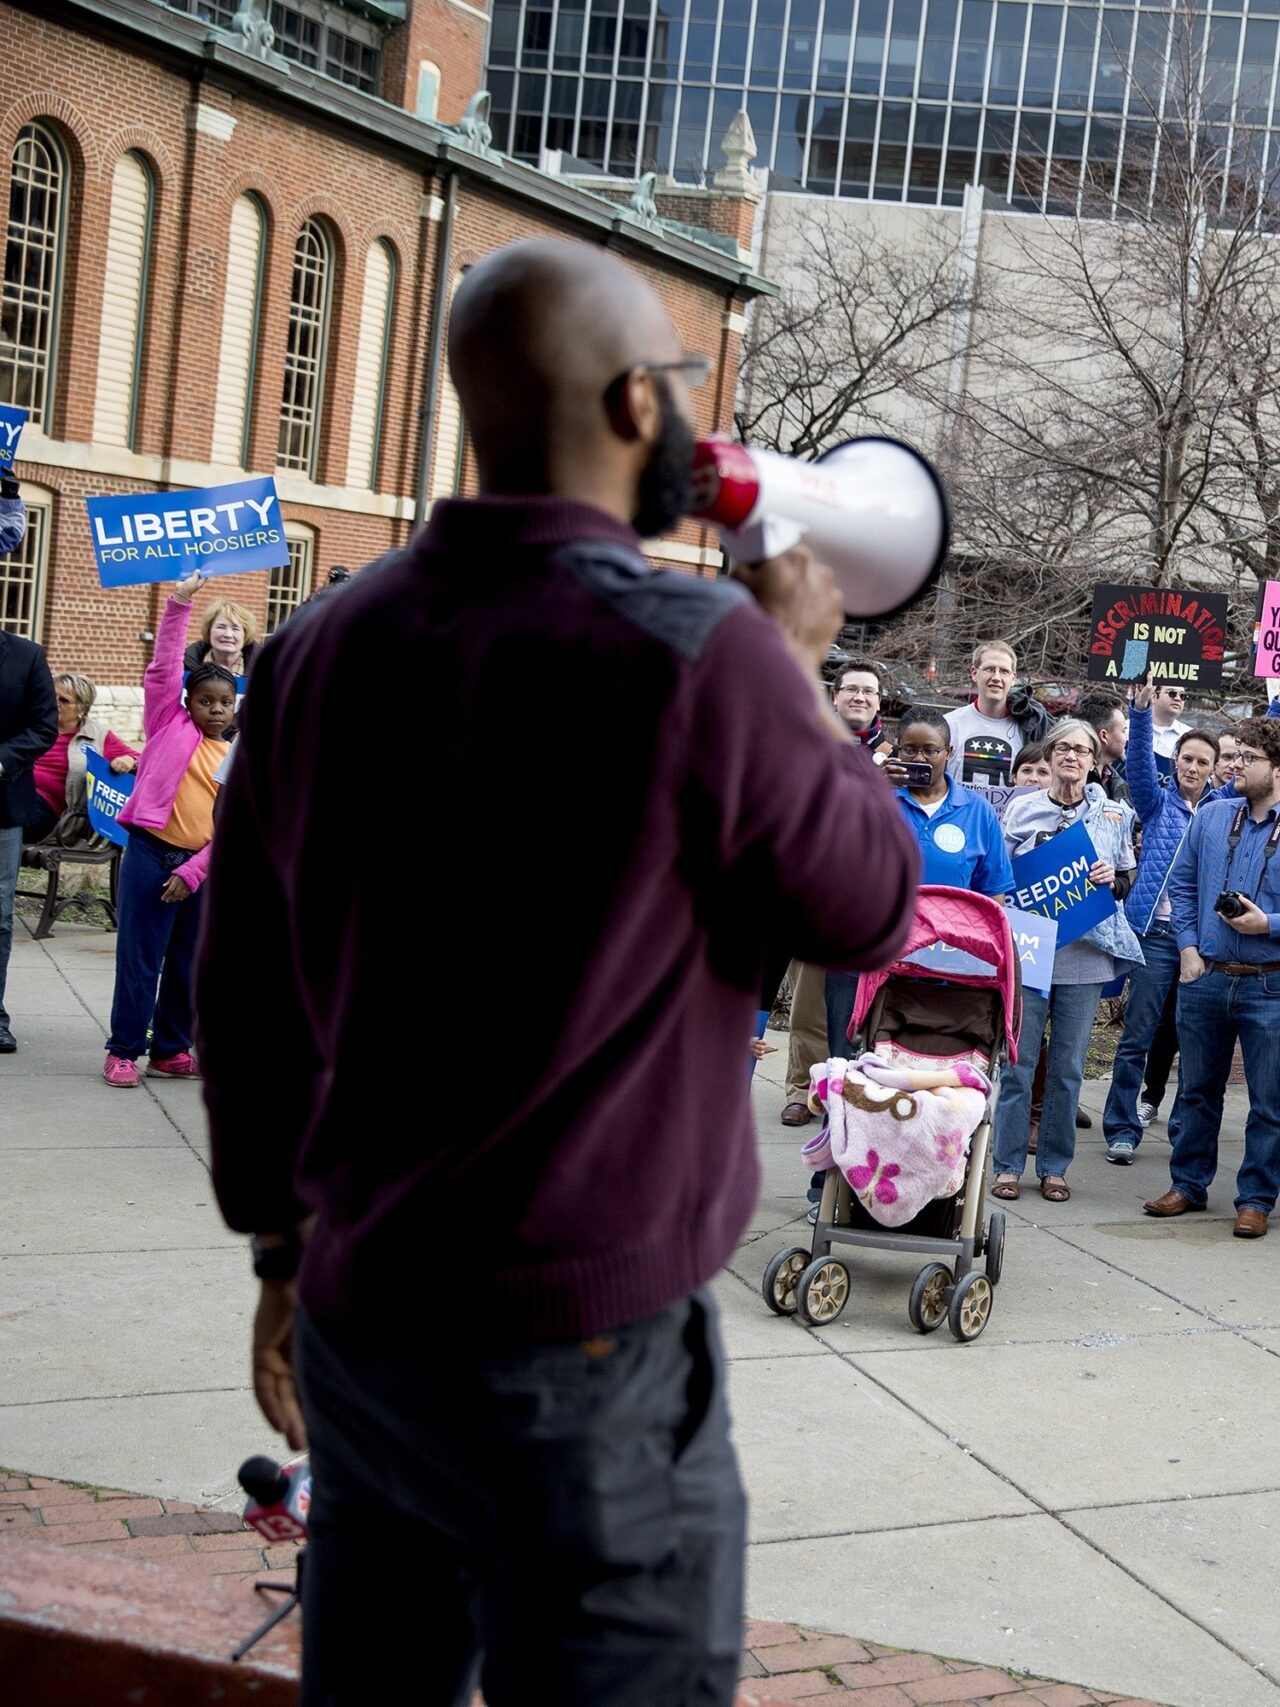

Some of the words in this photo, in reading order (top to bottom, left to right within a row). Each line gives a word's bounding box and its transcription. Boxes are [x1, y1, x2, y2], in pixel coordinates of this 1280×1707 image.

[95, 496, 275, 546] LIBERTY
[101, 547, 140, 563] FOR
[144, 543, 181, 559] ALL
[184, 529, 281, 556] HOOSIERS
[1090, 592, 1224, 661] DISCRIMINATION
[1133, 622, 1150, 640] IS
[1153, 626, 1186, 645] NOT
[1105, 660, 1118, 677] A
[1150, 661, 1200, 681] VALUE
[95, 780, 130, 806] FREE
[1004, 855, 1090, 910] REEDOM
[1030, 878, 1097, 920] IANA
